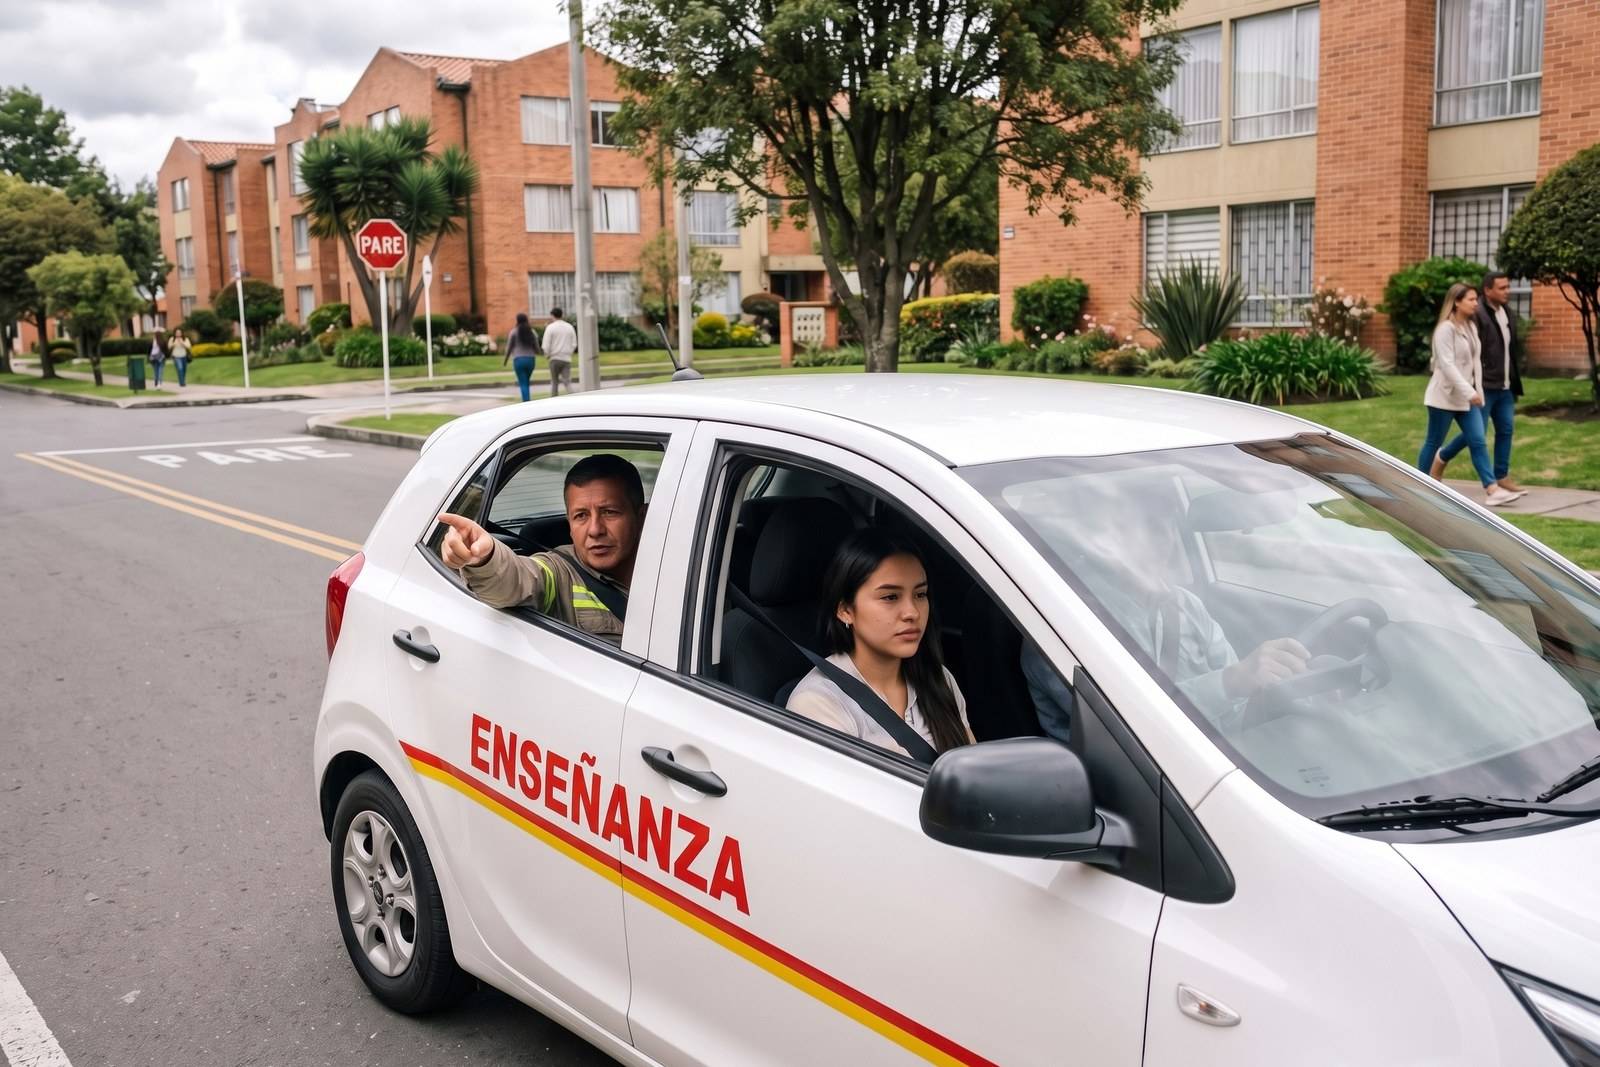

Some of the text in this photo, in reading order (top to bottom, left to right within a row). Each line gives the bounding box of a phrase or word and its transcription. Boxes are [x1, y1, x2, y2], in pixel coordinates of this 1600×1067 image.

[361, 236, 403, 254] PARE
[138, 446, 352, 468] PARE
[471, 713, 750, 916] ENSEÑANZA
